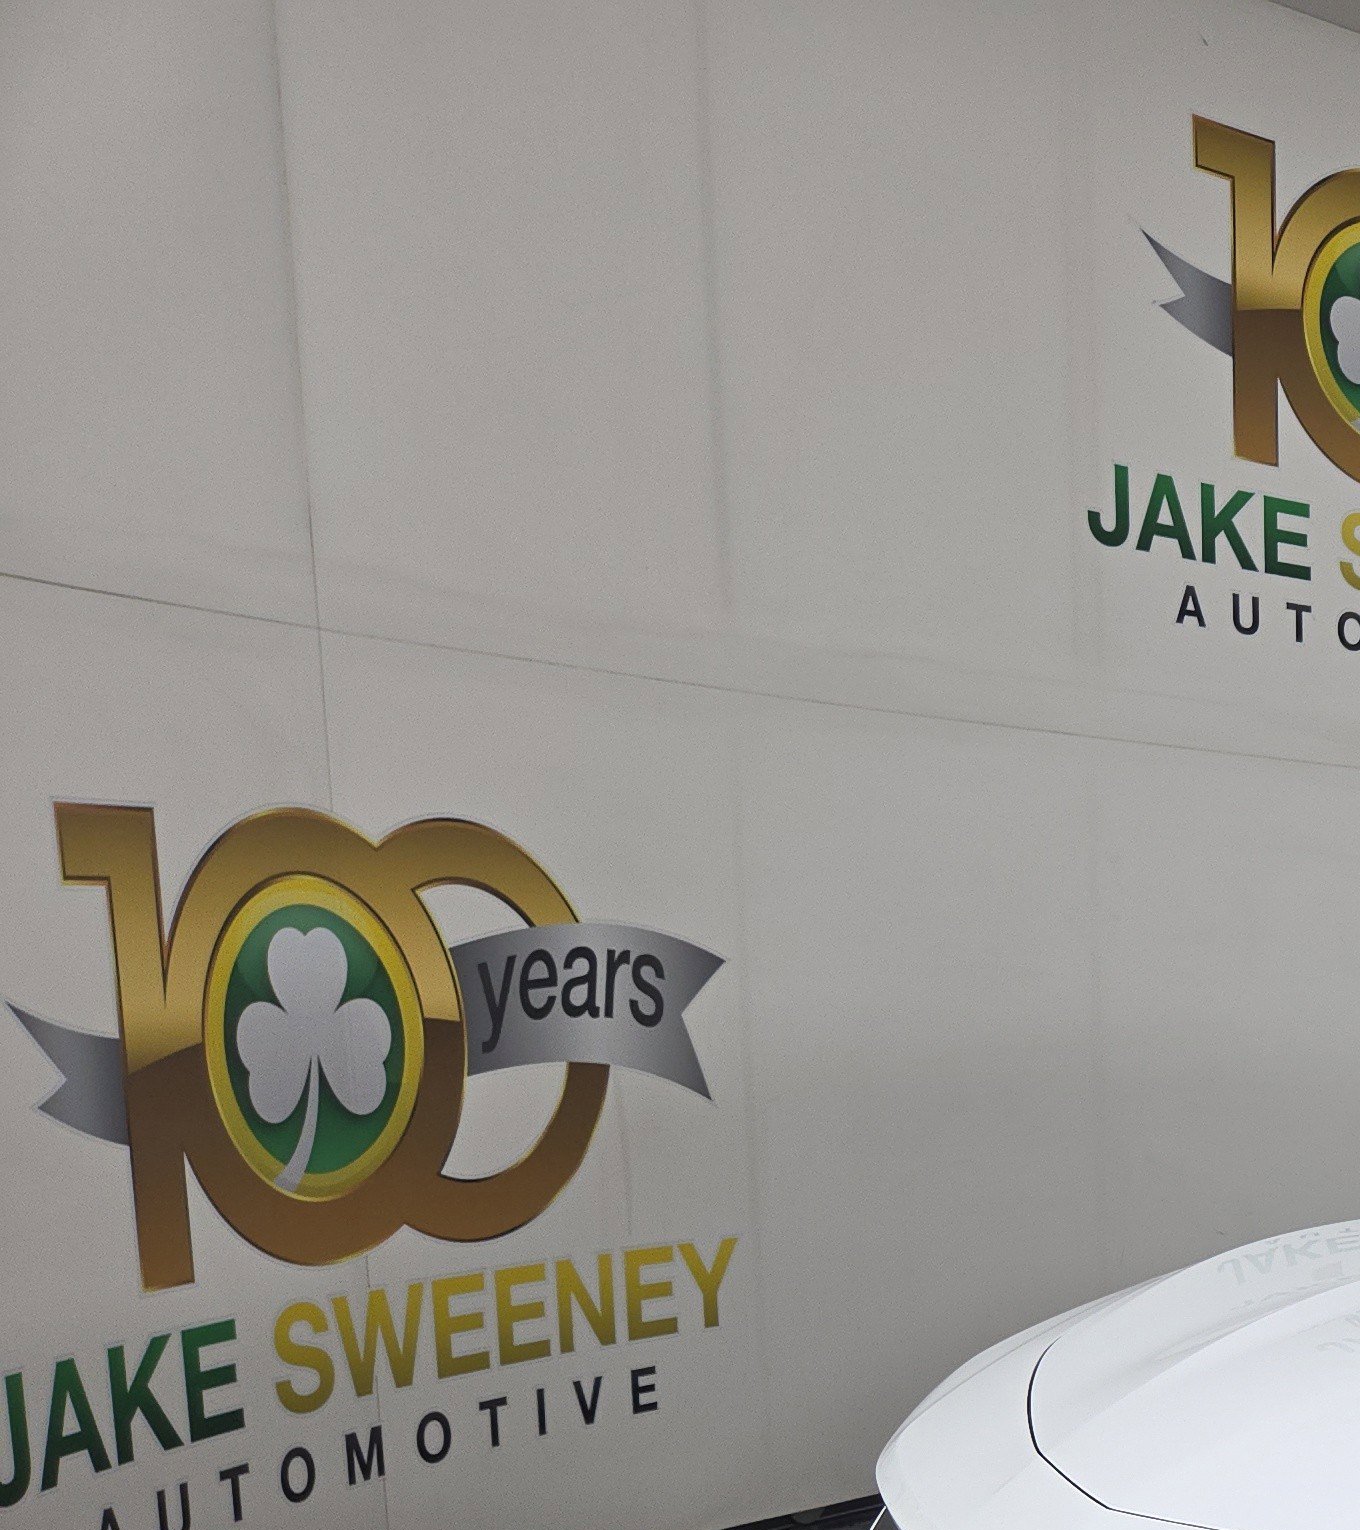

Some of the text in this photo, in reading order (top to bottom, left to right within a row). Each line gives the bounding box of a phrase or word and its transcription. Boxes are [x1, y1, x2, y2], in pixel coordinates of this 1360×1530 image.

[1086, 463, 1312, 582] JAKE
[53, 801, 667, 1293] 100 years
[0, 1237, 738, 1509] JAKE SWEENEY
